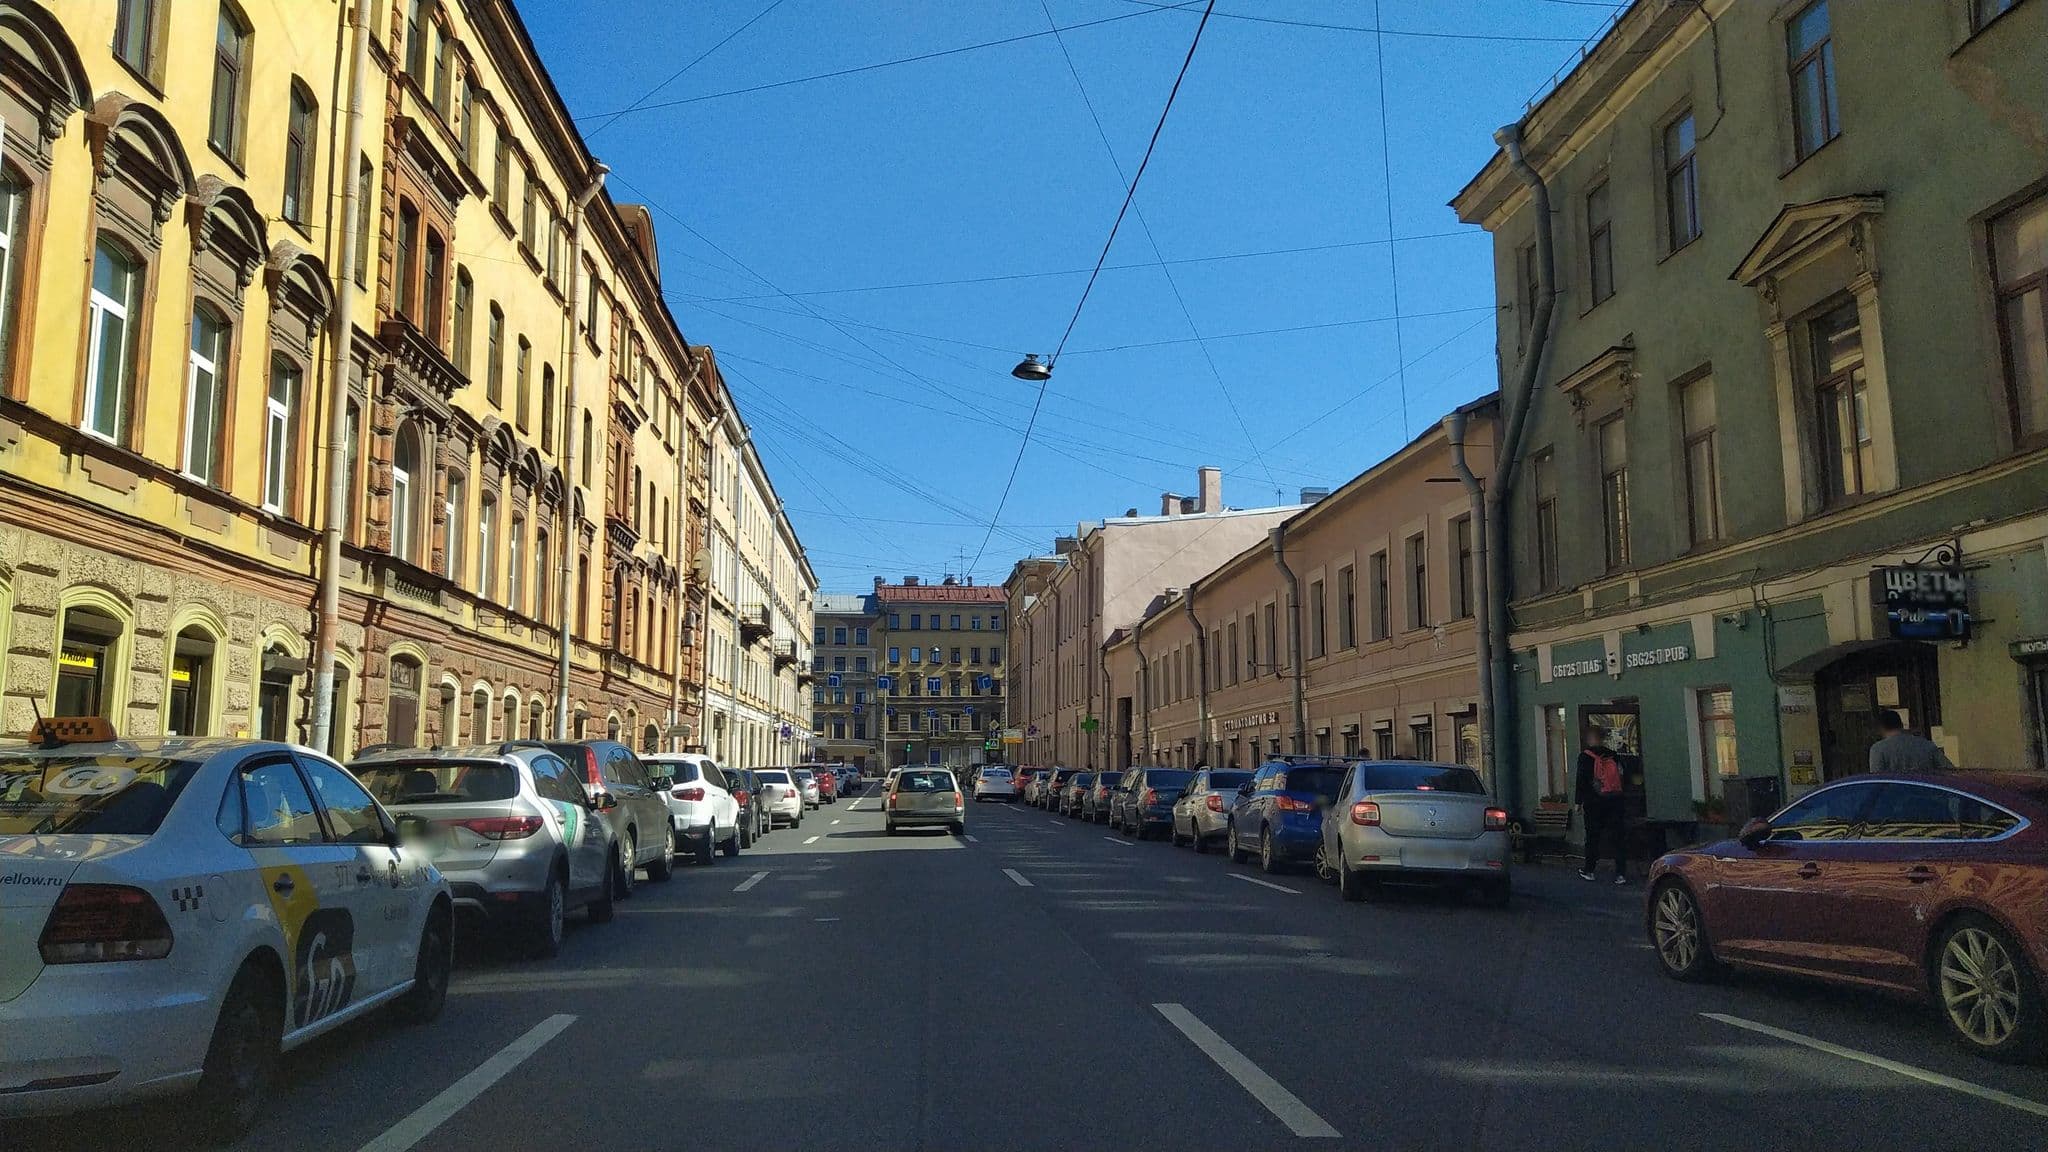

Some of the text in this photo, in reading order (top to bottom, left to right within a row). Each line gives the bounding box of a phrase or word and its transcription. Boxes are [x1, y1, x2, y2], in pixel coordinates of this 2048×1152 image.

[1886, 570, 1966, 593] ЦВЕТЫ
[1897, 608, 1925, 622] Pub
[1665, 647, 1687, 662] PUB
